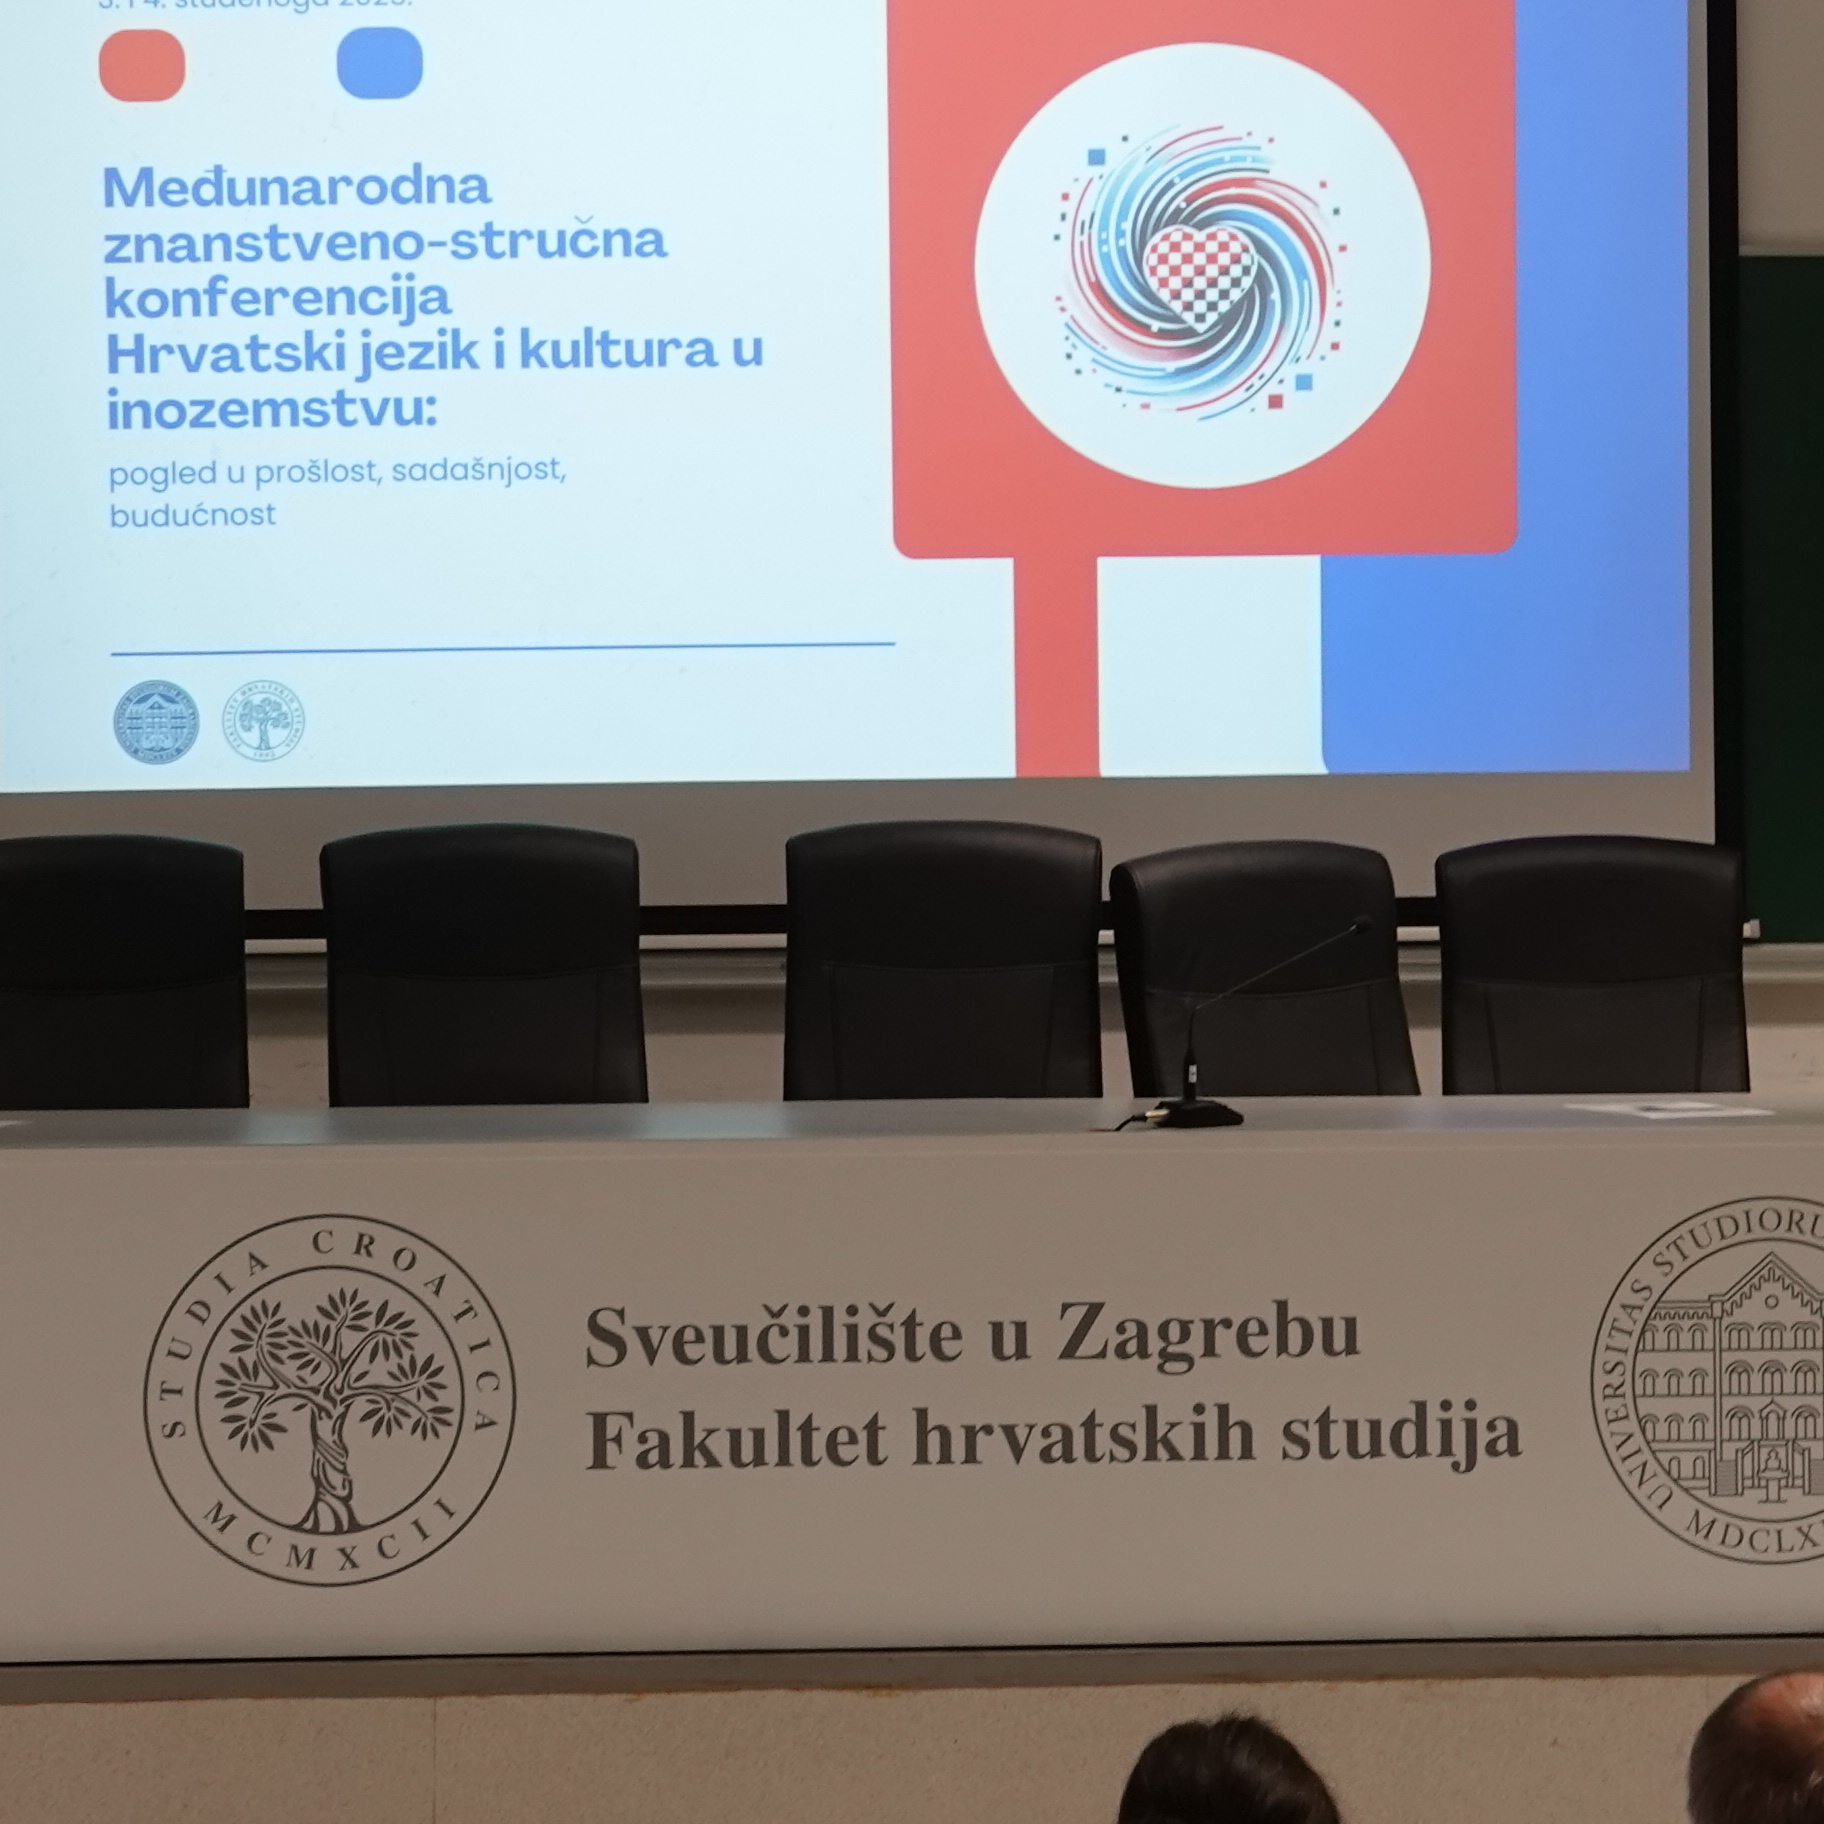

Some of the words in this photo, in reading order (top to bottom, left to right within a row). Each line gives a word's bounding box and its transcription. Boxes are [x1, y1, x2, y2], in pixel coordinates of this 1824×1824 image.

[103, 161, 494, 209] Međunarodna
[102, 215, 669, 265] znanstveno-stručna
[104, 271, 454, 328] konferencija
[107, 327, 346, 375] Hrvatski
[354, 324, 481, 384] jezik
[493, 325, 506, 370] i
[519, 325, 720, 370] kultura
[732, 337, 763, 368] u
[107, 386, 437, 431] inozemstvu:
[109, 459, 217, 494] pogled
[227, 465, 245, 485] u
[255, 458, 383, 492] prošlost,
[391, 455, 567, 489] sadašnjost,
[109, 501, 277, 530] budućnost
[159, 1250, 269, 1439] STUDIA
[312, 1229, 500, 1433] CROATICA
[586, 1301, 963, 1369] Sveučilište
[987, 1320, 1032, 1363] u
[1057, 1298, 1361, 1376] Zagrebu
[1602, 1279, 1673, 1511] UNIVERSITAS
[585, 1408, 889, 1471] Fakultet
[911, 1401, 1257, 1466] hrvatskih
[1281, 1397, 1523, 1475] studija
[203, 1497, 456, 1571] MCMXCII
